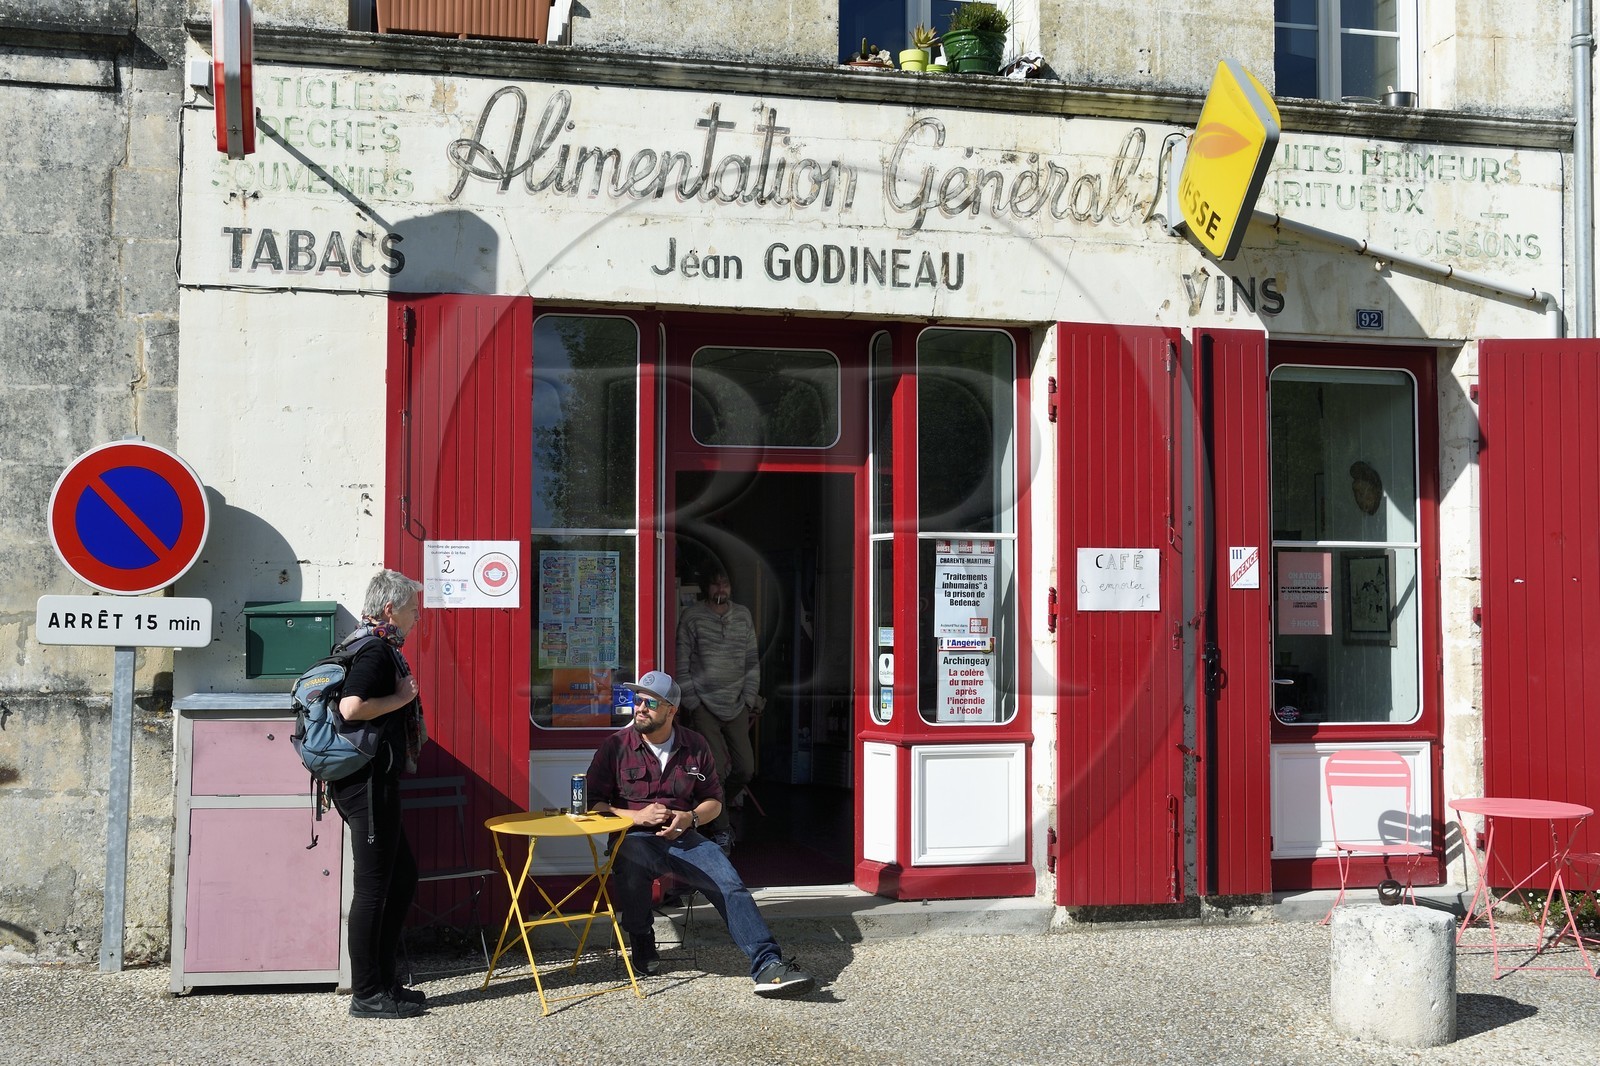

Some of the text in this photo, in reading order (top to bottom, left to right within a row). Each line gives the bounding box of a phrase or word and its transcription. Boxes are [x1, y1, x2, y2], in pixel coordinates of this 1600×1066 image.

[446, 85, 858, 210] Alimentation
[1362, 148, 1522, 184] PRIMEURS
[222, 226, 406, 276] TABACS
[650, 237, 965, 291] Jean GODINEAU
[1183, 275, 1285, 315] VINS
[1361, 313, 1379, 327] 92
[440, 560, 455, 574] 2
[1095, 550, 1144, 571] CAFÉ
[1230, 549, 1258, 587] LICENCE
[953, 590, 975, 599] prison
[1080, 580, 1144, 594] à emporter
[48, 610, 200, 631] ARRÊT 15 min
[947, 639, 986, 647] l'Angérien
[943, 657, 990, 666] Archingeay
[956, 688, 977, 697] après
